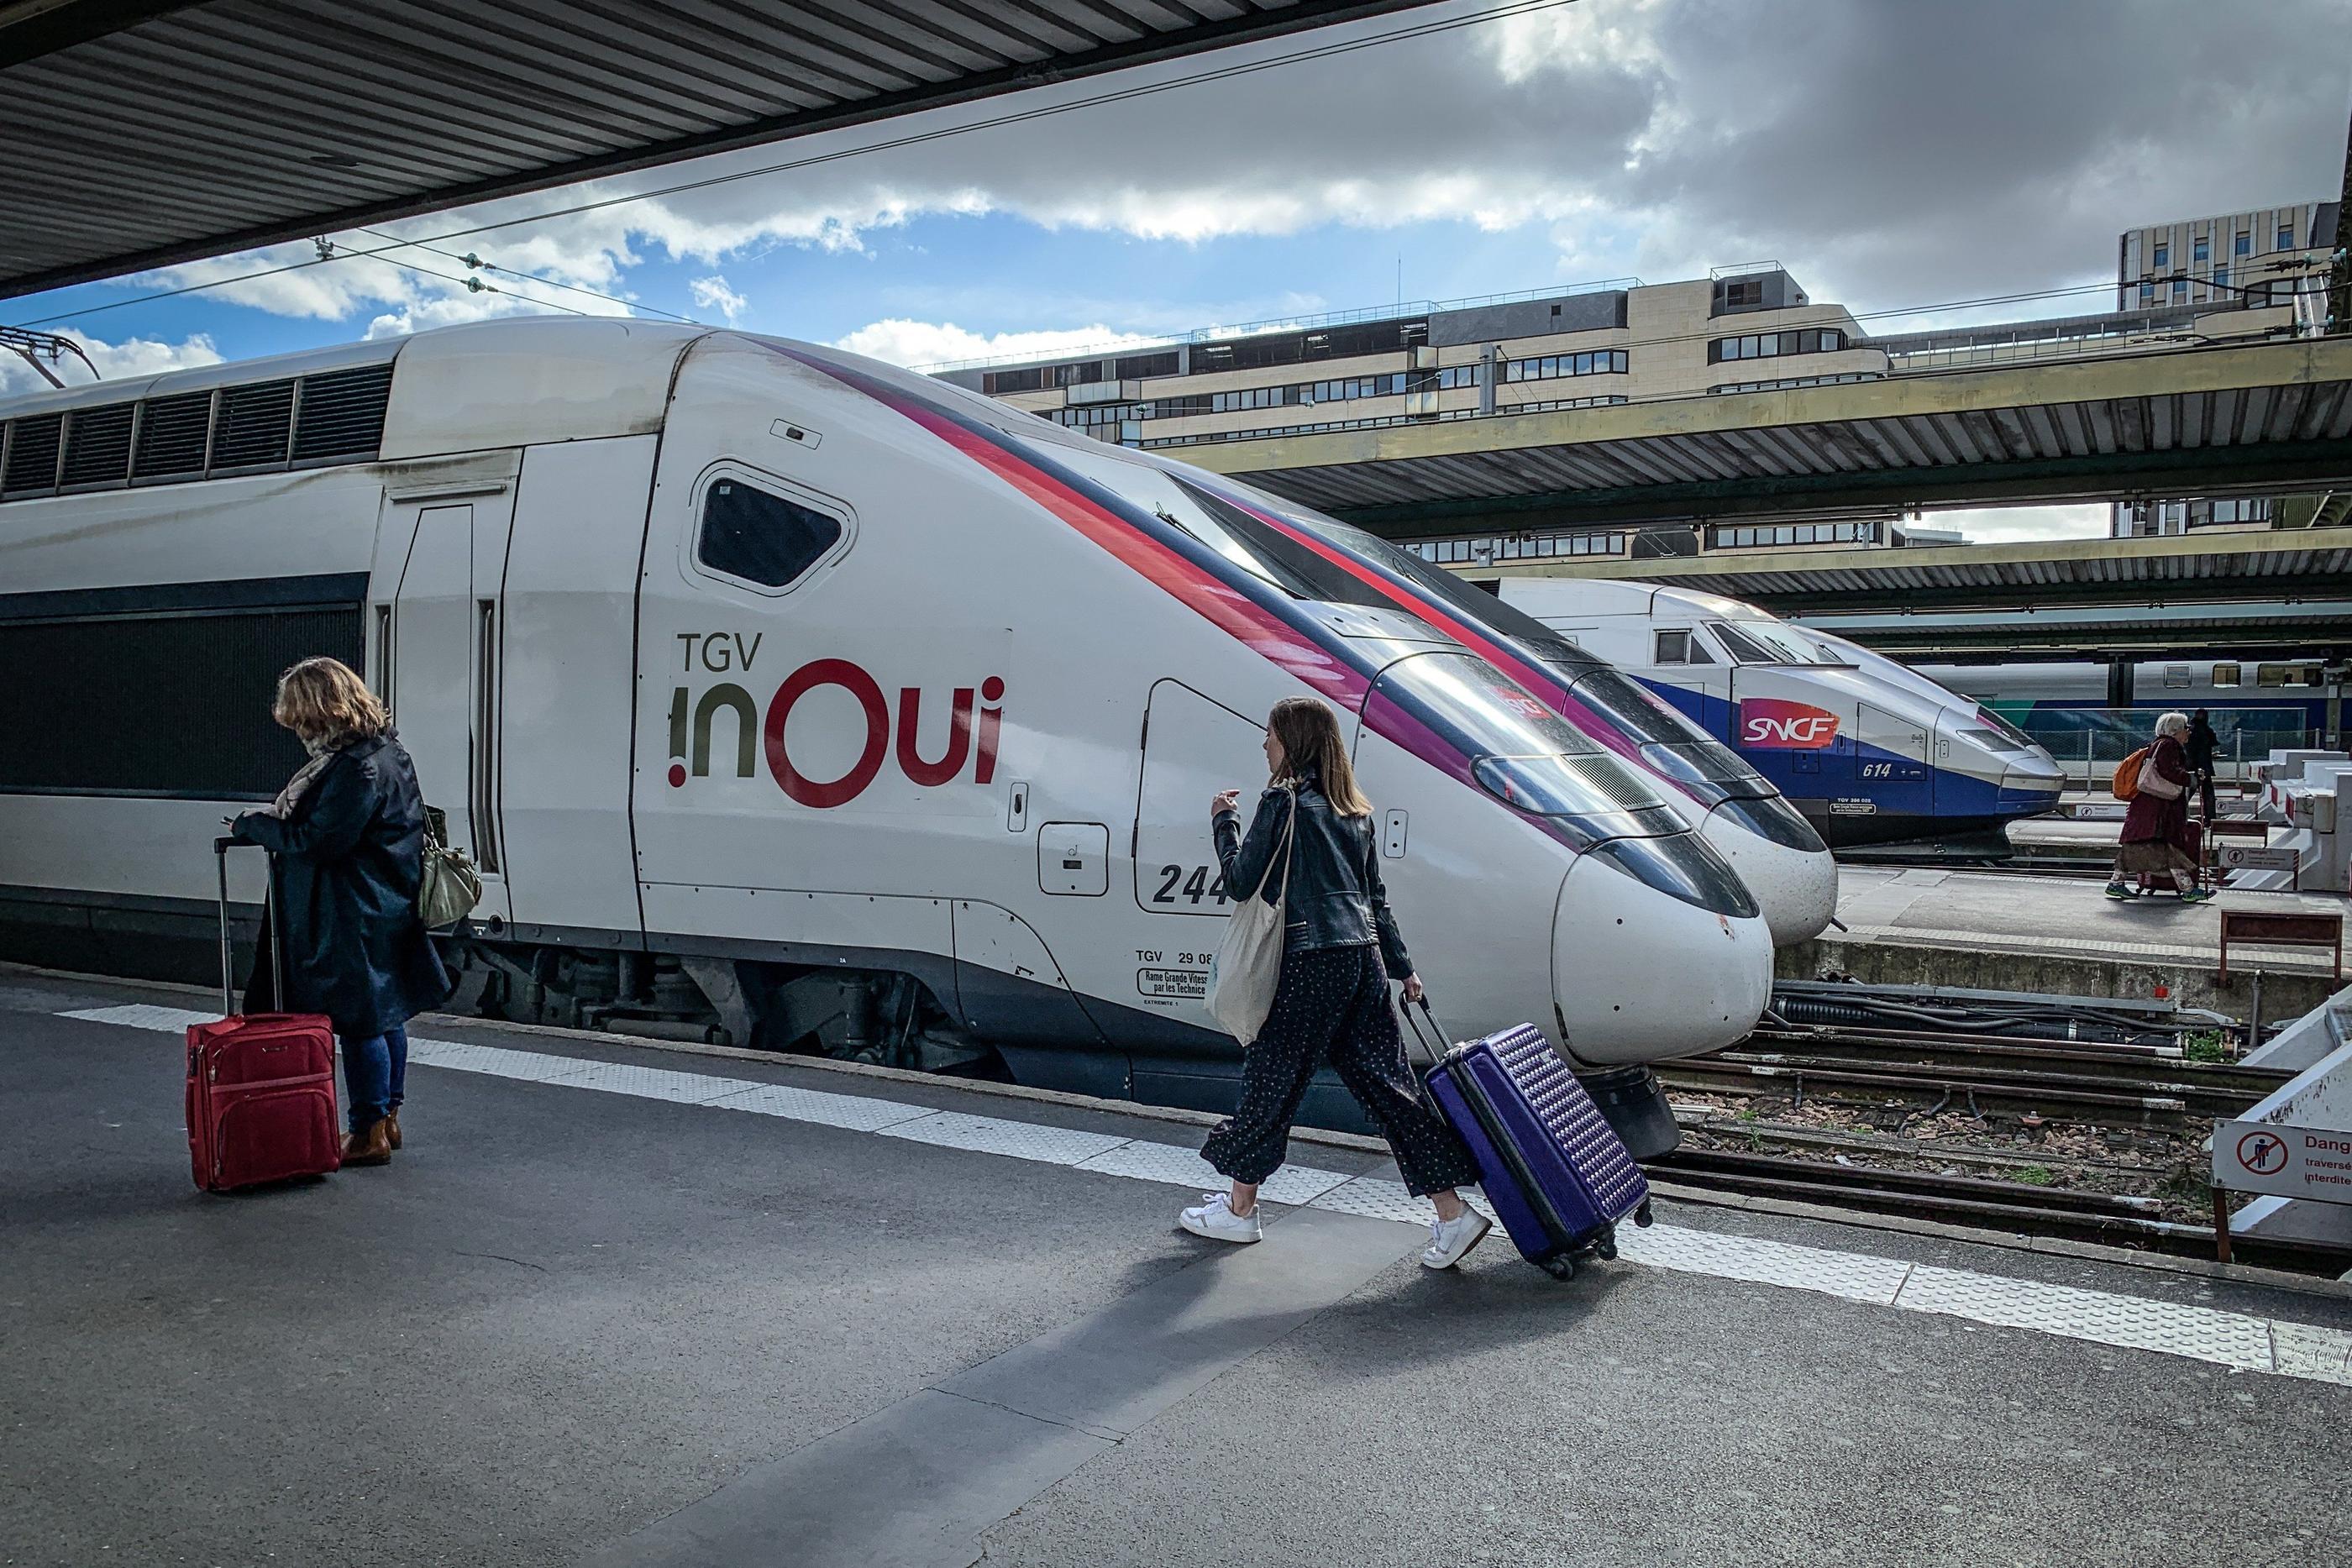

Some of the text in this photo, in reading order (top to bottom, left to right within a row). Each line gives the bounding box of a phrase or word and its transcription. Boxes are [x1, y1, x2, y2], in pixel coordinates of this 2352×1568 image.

[677, 632, 762, 673] TGV
[1744, 717, 1835, 742] SNCF
[1863, 763, 1892, 778] 614
[1152, 864, 1228, 905] 244
[1136, 950, 1163, 962] TGV
[1179, 952, 1194, 964] 29
[1145, 971, 1163, 981] Rame
[1164, 972, 1187, 983] Grande
[1153, 982, 1205, 994] par les Technice
[2305, 1135, 2352, 1155] Dang
